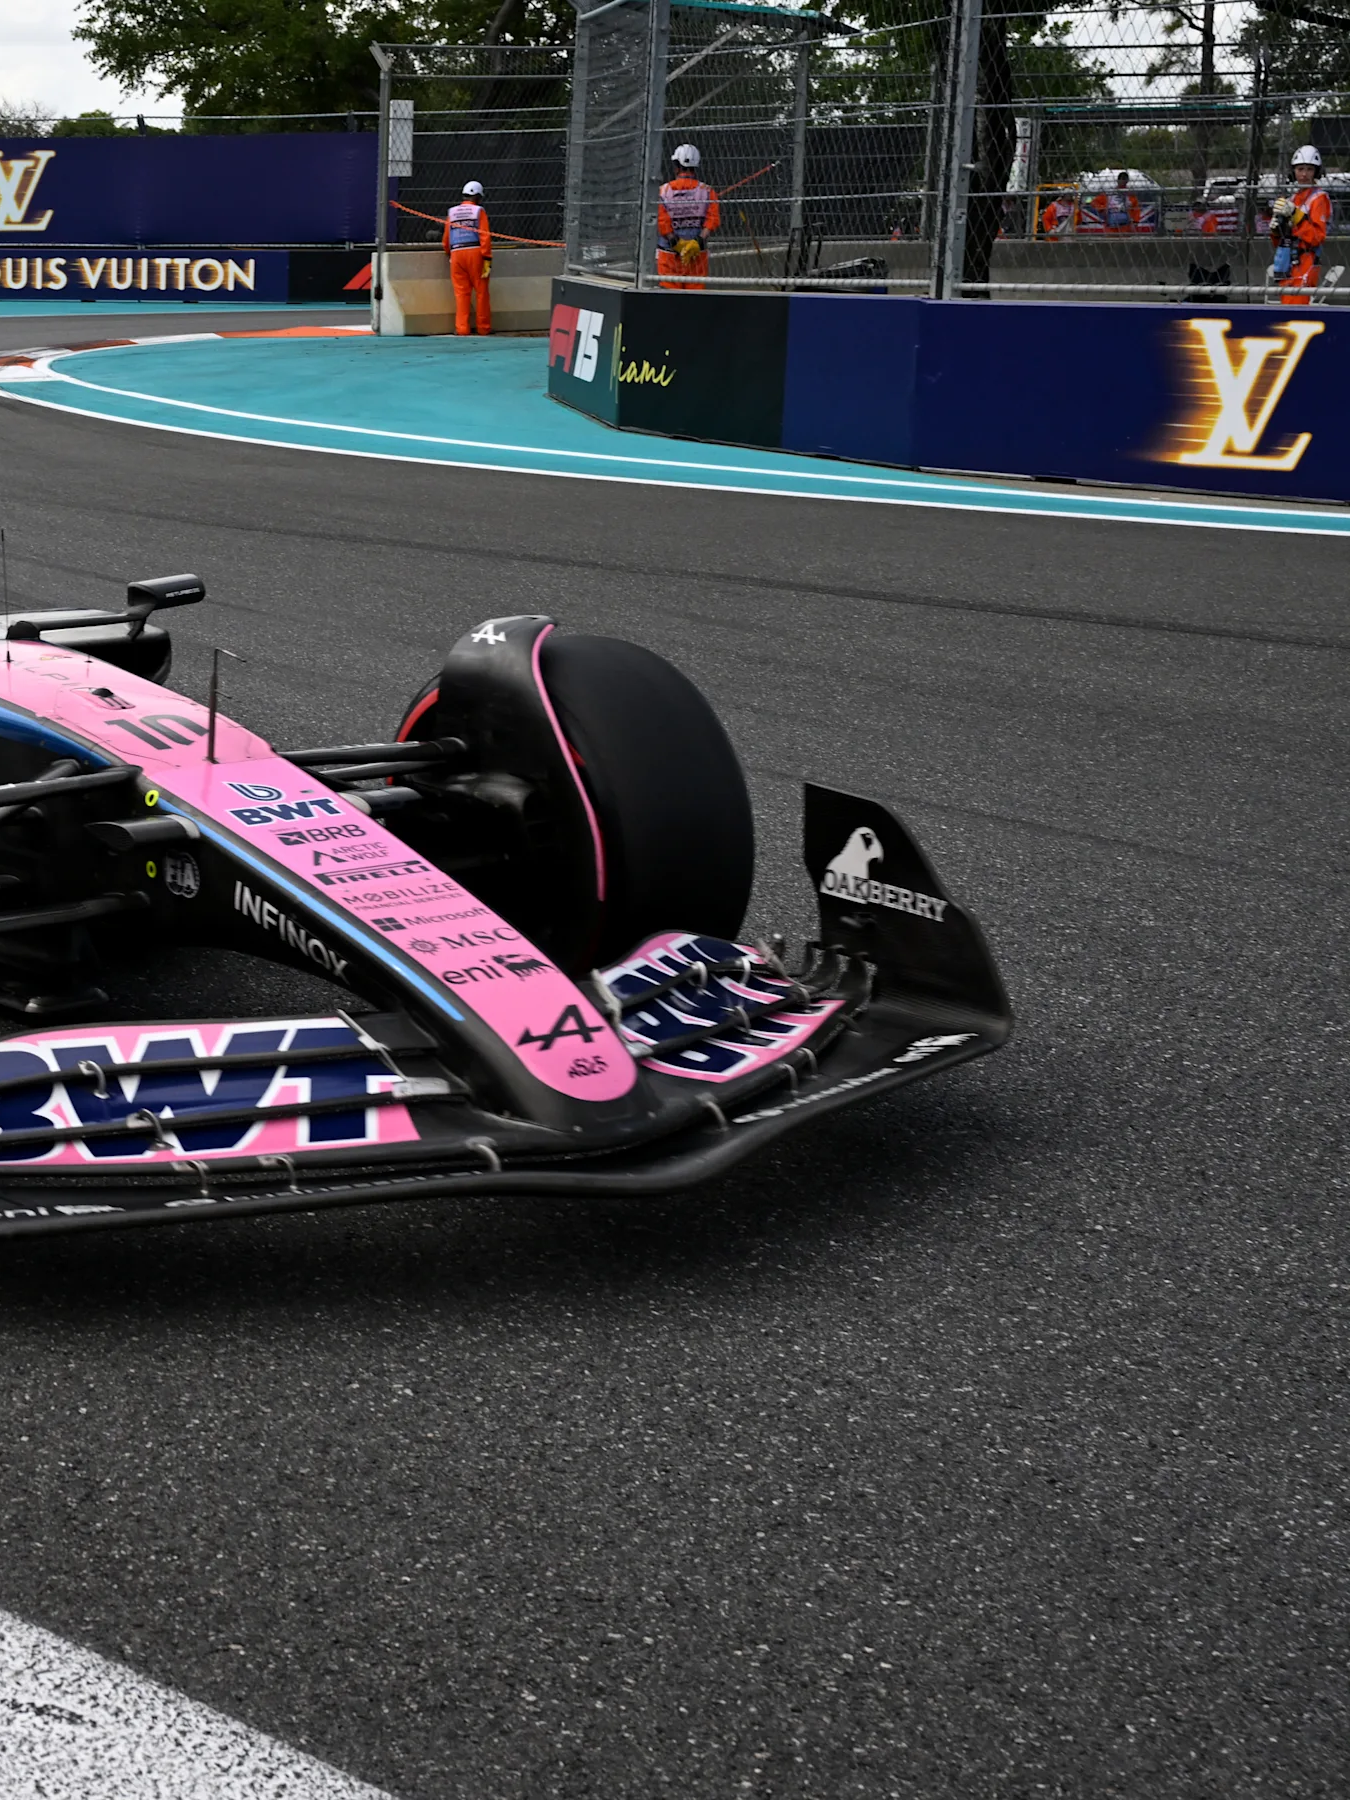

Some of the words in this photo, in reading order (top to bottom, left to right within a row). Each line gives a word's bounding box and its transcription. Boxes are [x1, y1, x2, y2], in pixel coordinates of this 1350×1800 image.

[80, 257, 255, 291] VUITTON
[104, 713, 210, 751] 10
[229, 798, 342, 827] BWT
[306, 824, 368, 843] BRB
[331, 842, 389, 856] ARCTIC
[345, 849, 391, 862] WOLF
[313, 859, 432, 887] PIRELLI
[355, 899, 412, 912] FINANCIAL
[820, 869, 948, 922] OAKBERRY
[404, 906, 491, 927] Microsoft
[438, 927, 522, 950] MSC
[442, 958, 506, 985] eni
